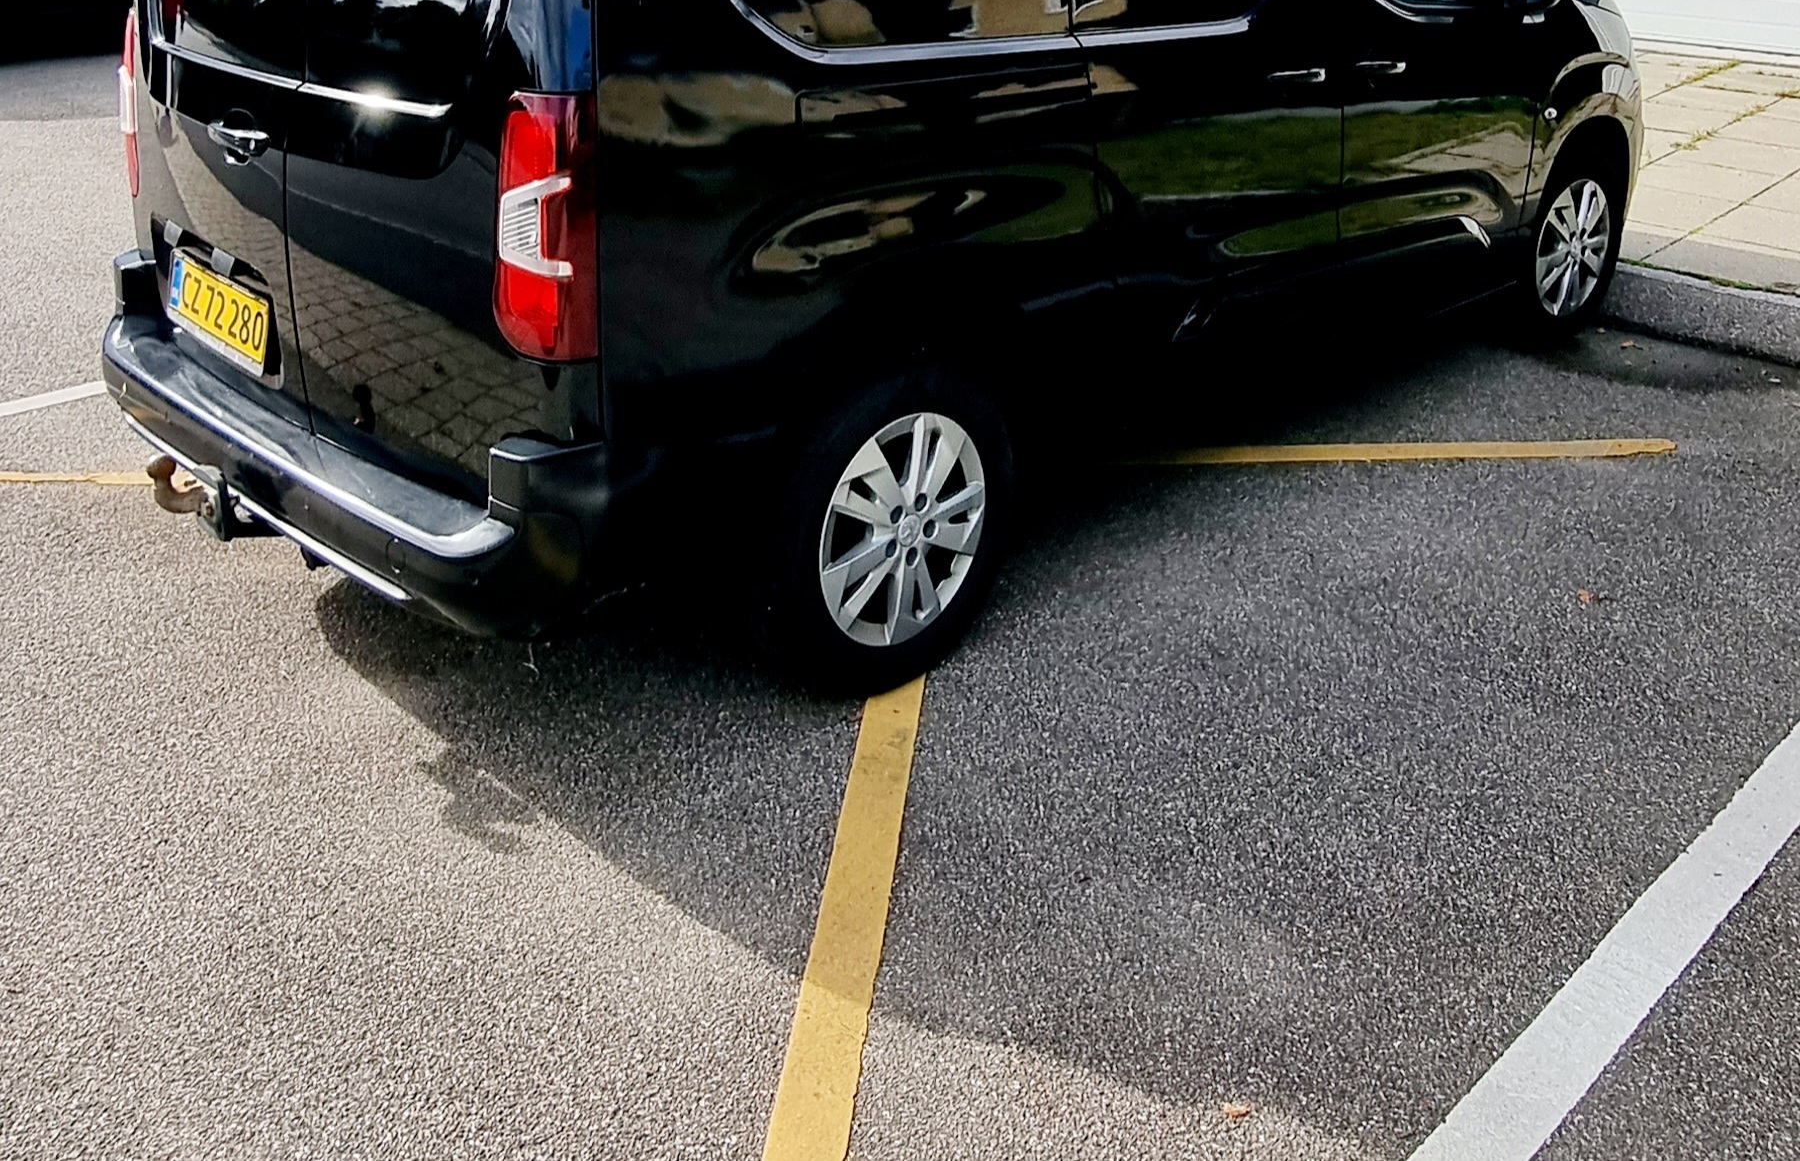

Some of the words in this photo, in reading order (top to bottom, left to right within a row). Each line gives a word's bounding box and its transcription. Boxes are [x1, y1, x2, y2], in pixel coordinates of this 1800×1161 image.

[182, 271, 202, 315] CZ
[205, 284, 225, 330] 72
[227, 298, 264, 351] 280
